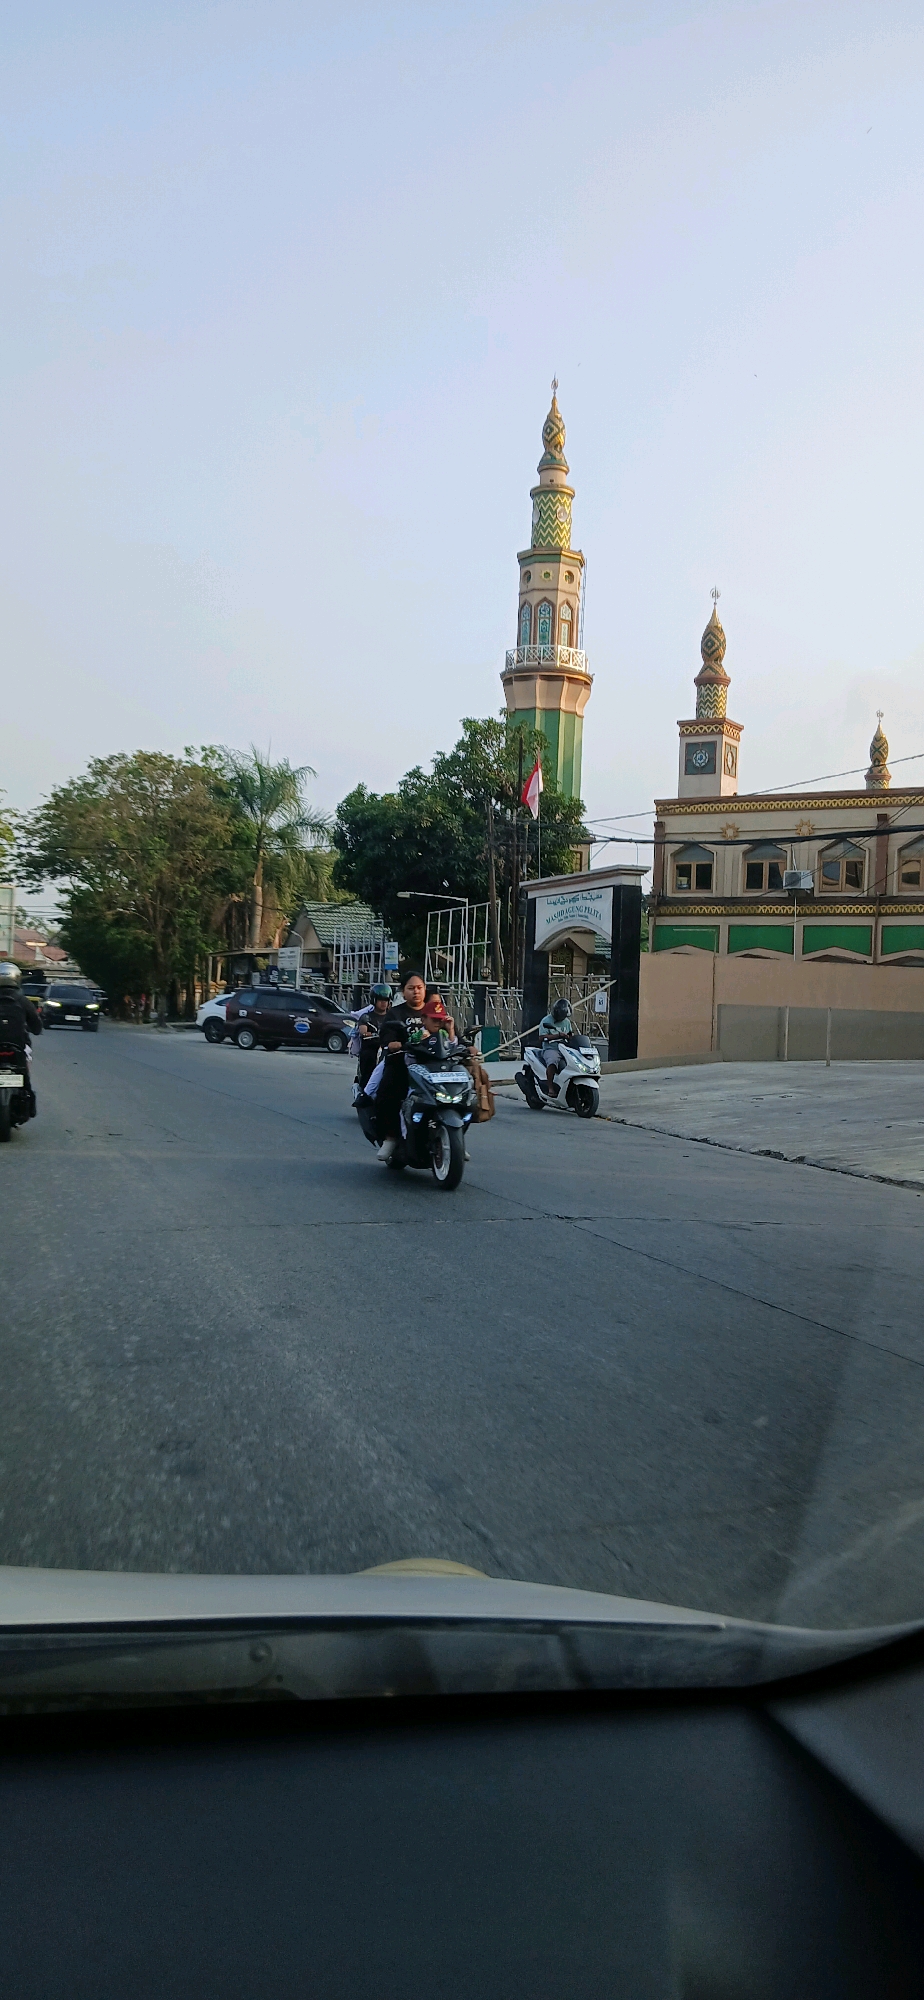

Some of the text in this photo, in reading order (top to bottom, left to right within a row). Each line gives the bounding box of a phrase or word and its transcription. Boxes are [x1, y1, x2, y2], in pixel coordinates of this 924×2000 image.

[546, 910, 564, 924] MASJID
[565, 905, 583, 914] AGUNG
[584, 906, 602, 920] PELITA
